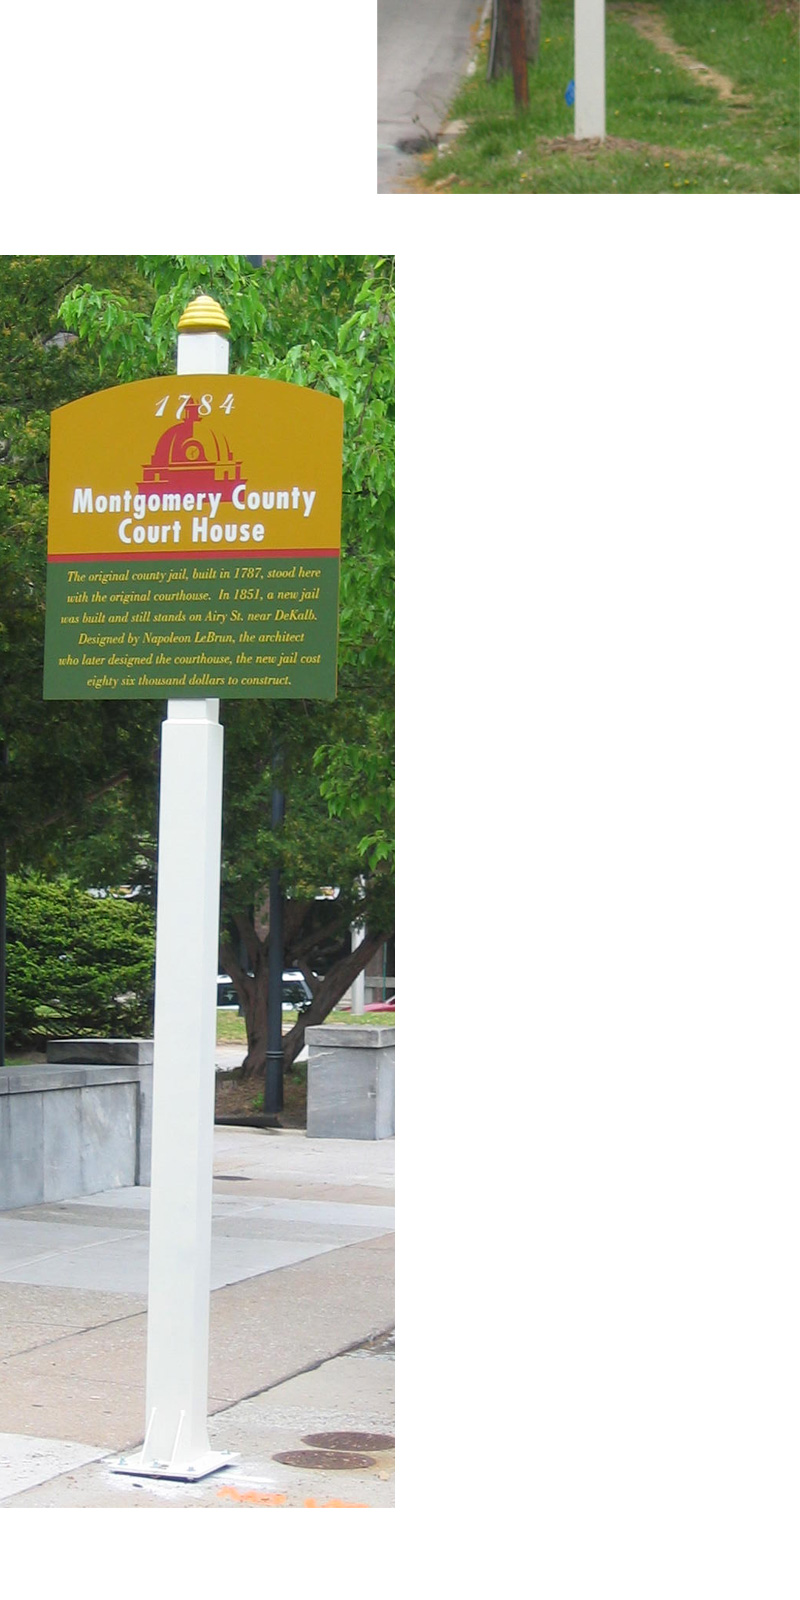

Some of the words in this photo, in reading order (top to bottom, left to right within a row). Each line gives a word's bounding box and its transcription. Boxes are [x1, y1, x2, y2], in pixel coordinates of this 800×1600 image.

[155, 393, 235, 420] 1784
[72, 488, 222, 520] Montgomery
[232, 484, 316, 517] County
[118, 518, 181, 543] Court
[192, 517, 265, 542] House
[67, 570, 85, 582] The
[88, 570, 129, 584] original
[132, 571, 166, 583] county
[167, 568, 188, 583] jail,
[193, 568, 216, 579] built
[220, 568, 230, 579] in
[234, 568, 263, 579] 1787,
[267, 567, 296, 578] stood
[298, 567, 321, 578] here
[67, 592, 88, 603] with
[92, 591, 107, 602] the
[110, 591, 151, 604] original
[154, 590, 211, 601] courthouse.
[219, 589, 230, 599] In
[234, 589, 263, 600] 1851,
[299, 588, 319, 602] jail
[82, 612, 105, 623] built
[108, 612, 129, 623] and
[131, 612, 151, 622] still
[153, 611, 186, 622] stands
[189, 613, 201, 621] on
[205, 610, 227, 624] Airy
[230, 610, 243, 621] St.
[275, 609, 317, 620] DeKalb.
[79, 633, 125, 647] Designed
[128, 633, 140, 646] by
[142, 632, 191, 646] Napoleon
[194, 631, 235, 644] LeBrun,
[239, 631, 255, 642] the
[259, 631, 305, 642] architect
[59, 655, 79, 665] who
[82, 654, 105, 665] later
[108, 653, 153, 667] designed
[156, 653, 171, 664] the
[174, 653, 232, 665] courthouse,
[236, 653, 252, 664] the
[277, 652, 298, 666] jail
[301, 654, 321, 664] cost
[87, 675, 118, 689] eighty
[121, 675, 135, 686] six
[138, 674, 187, 685] thousand
[189, 674, 225, 685] dollars
[228, 676, 238, 685] to
[241, 676, 291, 685] construct.
